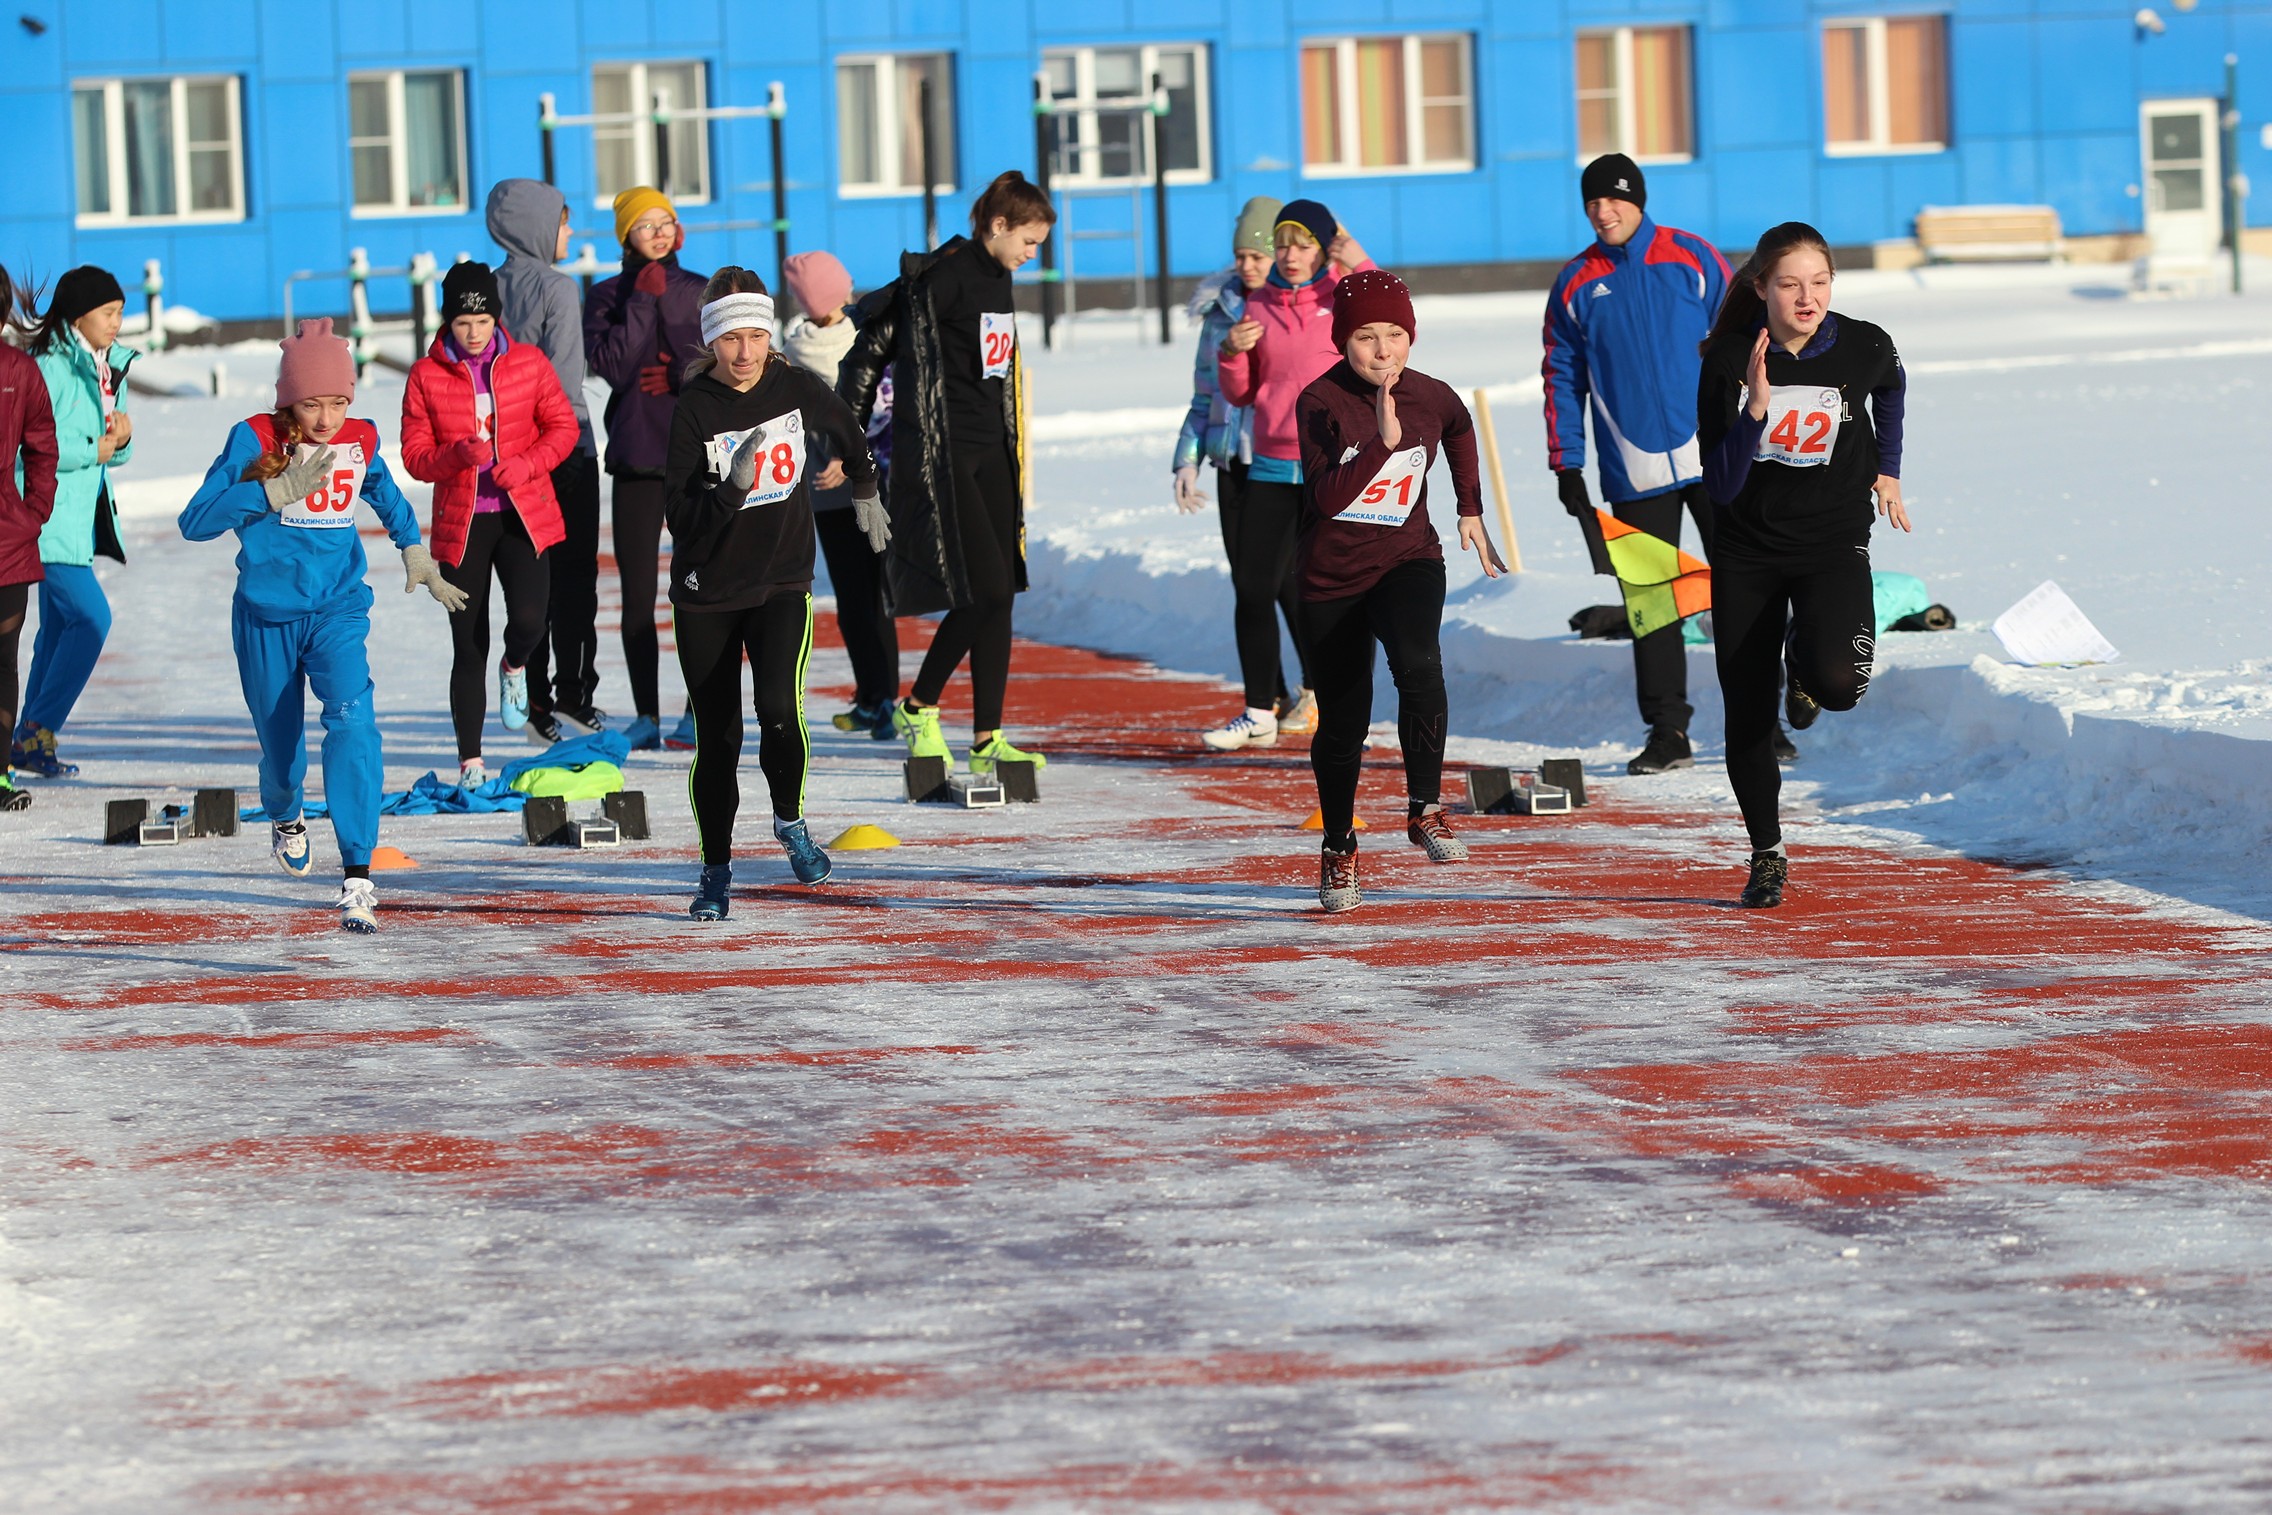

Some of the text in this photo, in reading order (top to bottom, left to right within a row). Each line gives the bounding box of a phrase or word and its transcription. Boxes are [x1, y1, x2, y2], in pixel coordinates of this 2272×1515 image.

[1769, 410, 1831, 453] 42
[1793, 457, 1827, 465] ОБЛАСТЬ
[1361, 475, 1413, 505] 51
[284, 517, 353, 525] САХАЛИНСКАЯ ОБЛА
